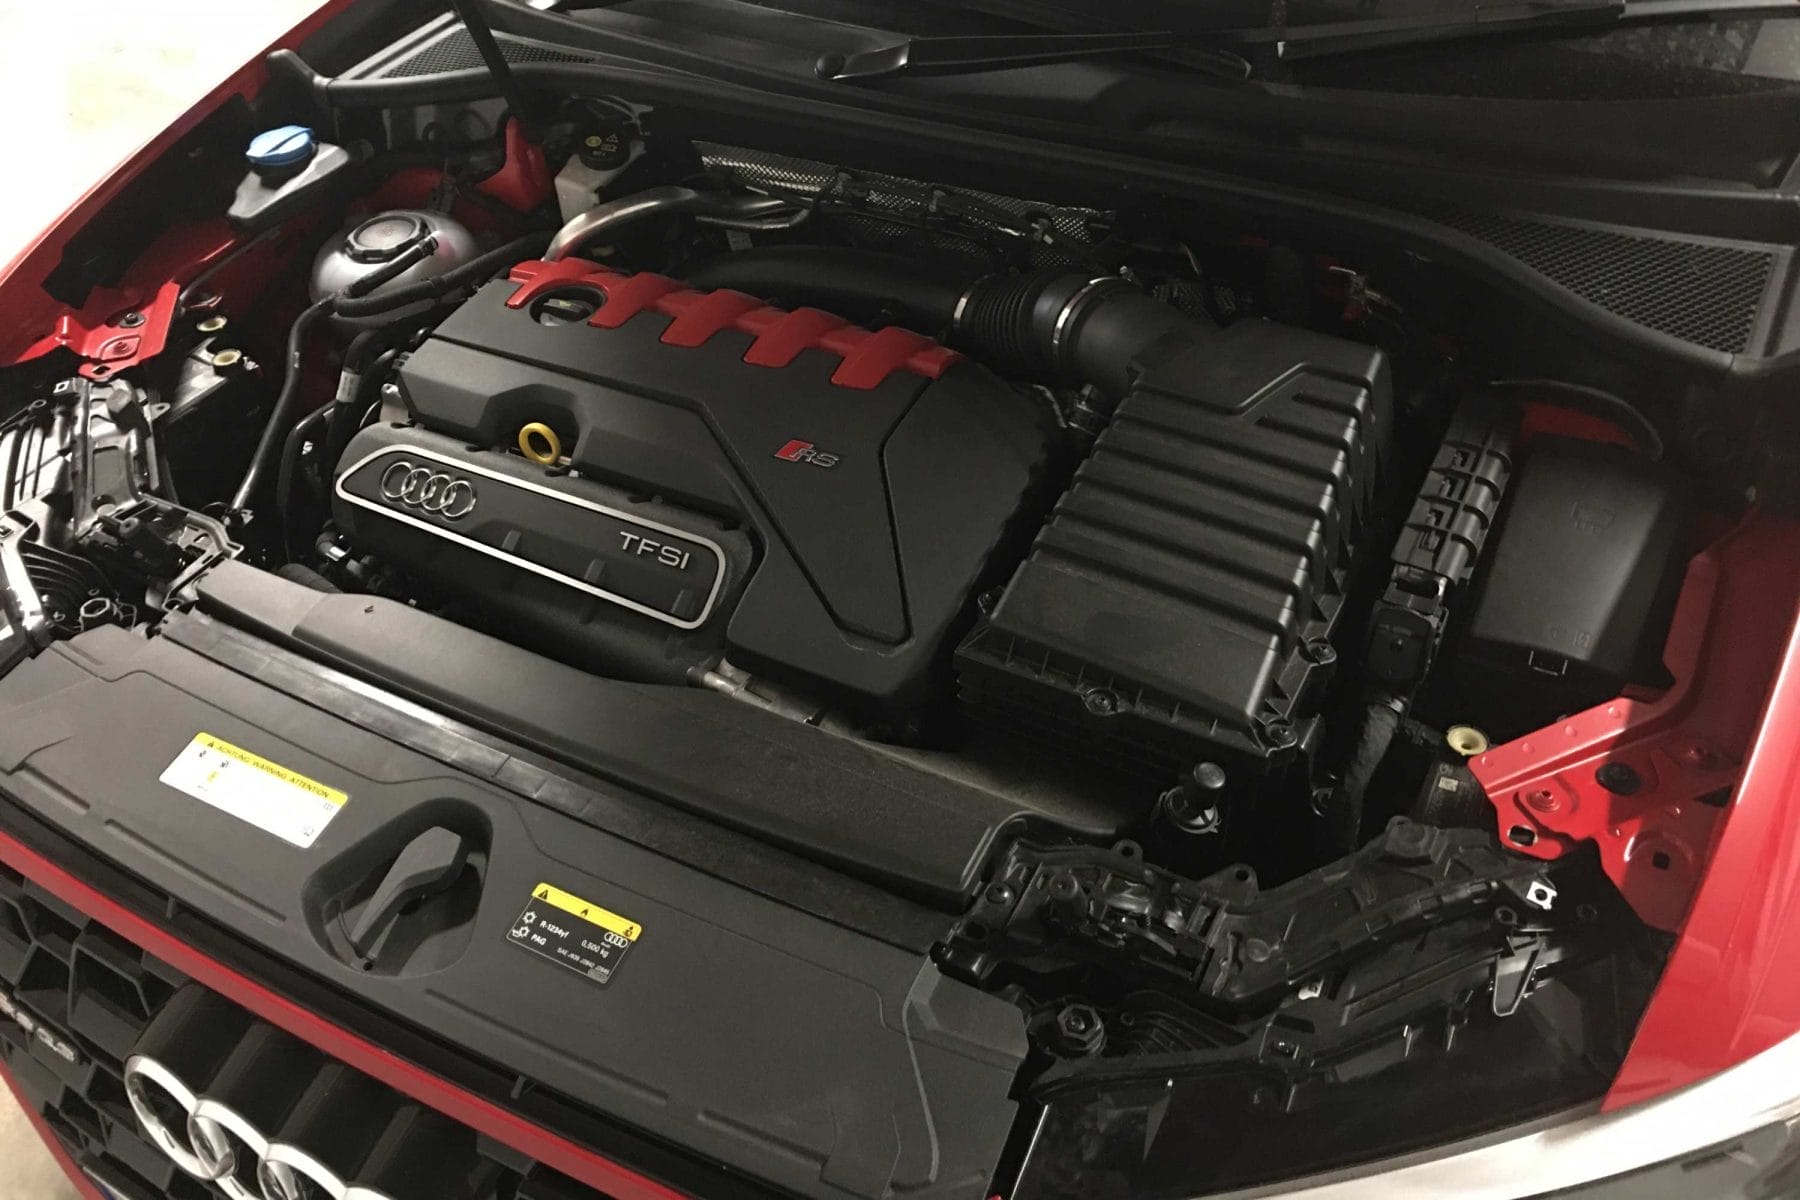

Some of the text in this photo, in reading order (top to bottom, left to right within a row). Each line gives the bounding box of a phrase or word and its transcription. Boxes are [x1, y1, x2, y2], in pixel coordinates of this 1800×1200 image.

[785, 445, 840, 468] RS
[620, 531, 690, 570] TFSI
[217, 744, 330, 798] ACHTUNG WARNING ATTENTION
[530, 934, 547, 946] PAG
[539, 920, 570, 938] R-1234yf
[599, 947, 610, 959] kg
